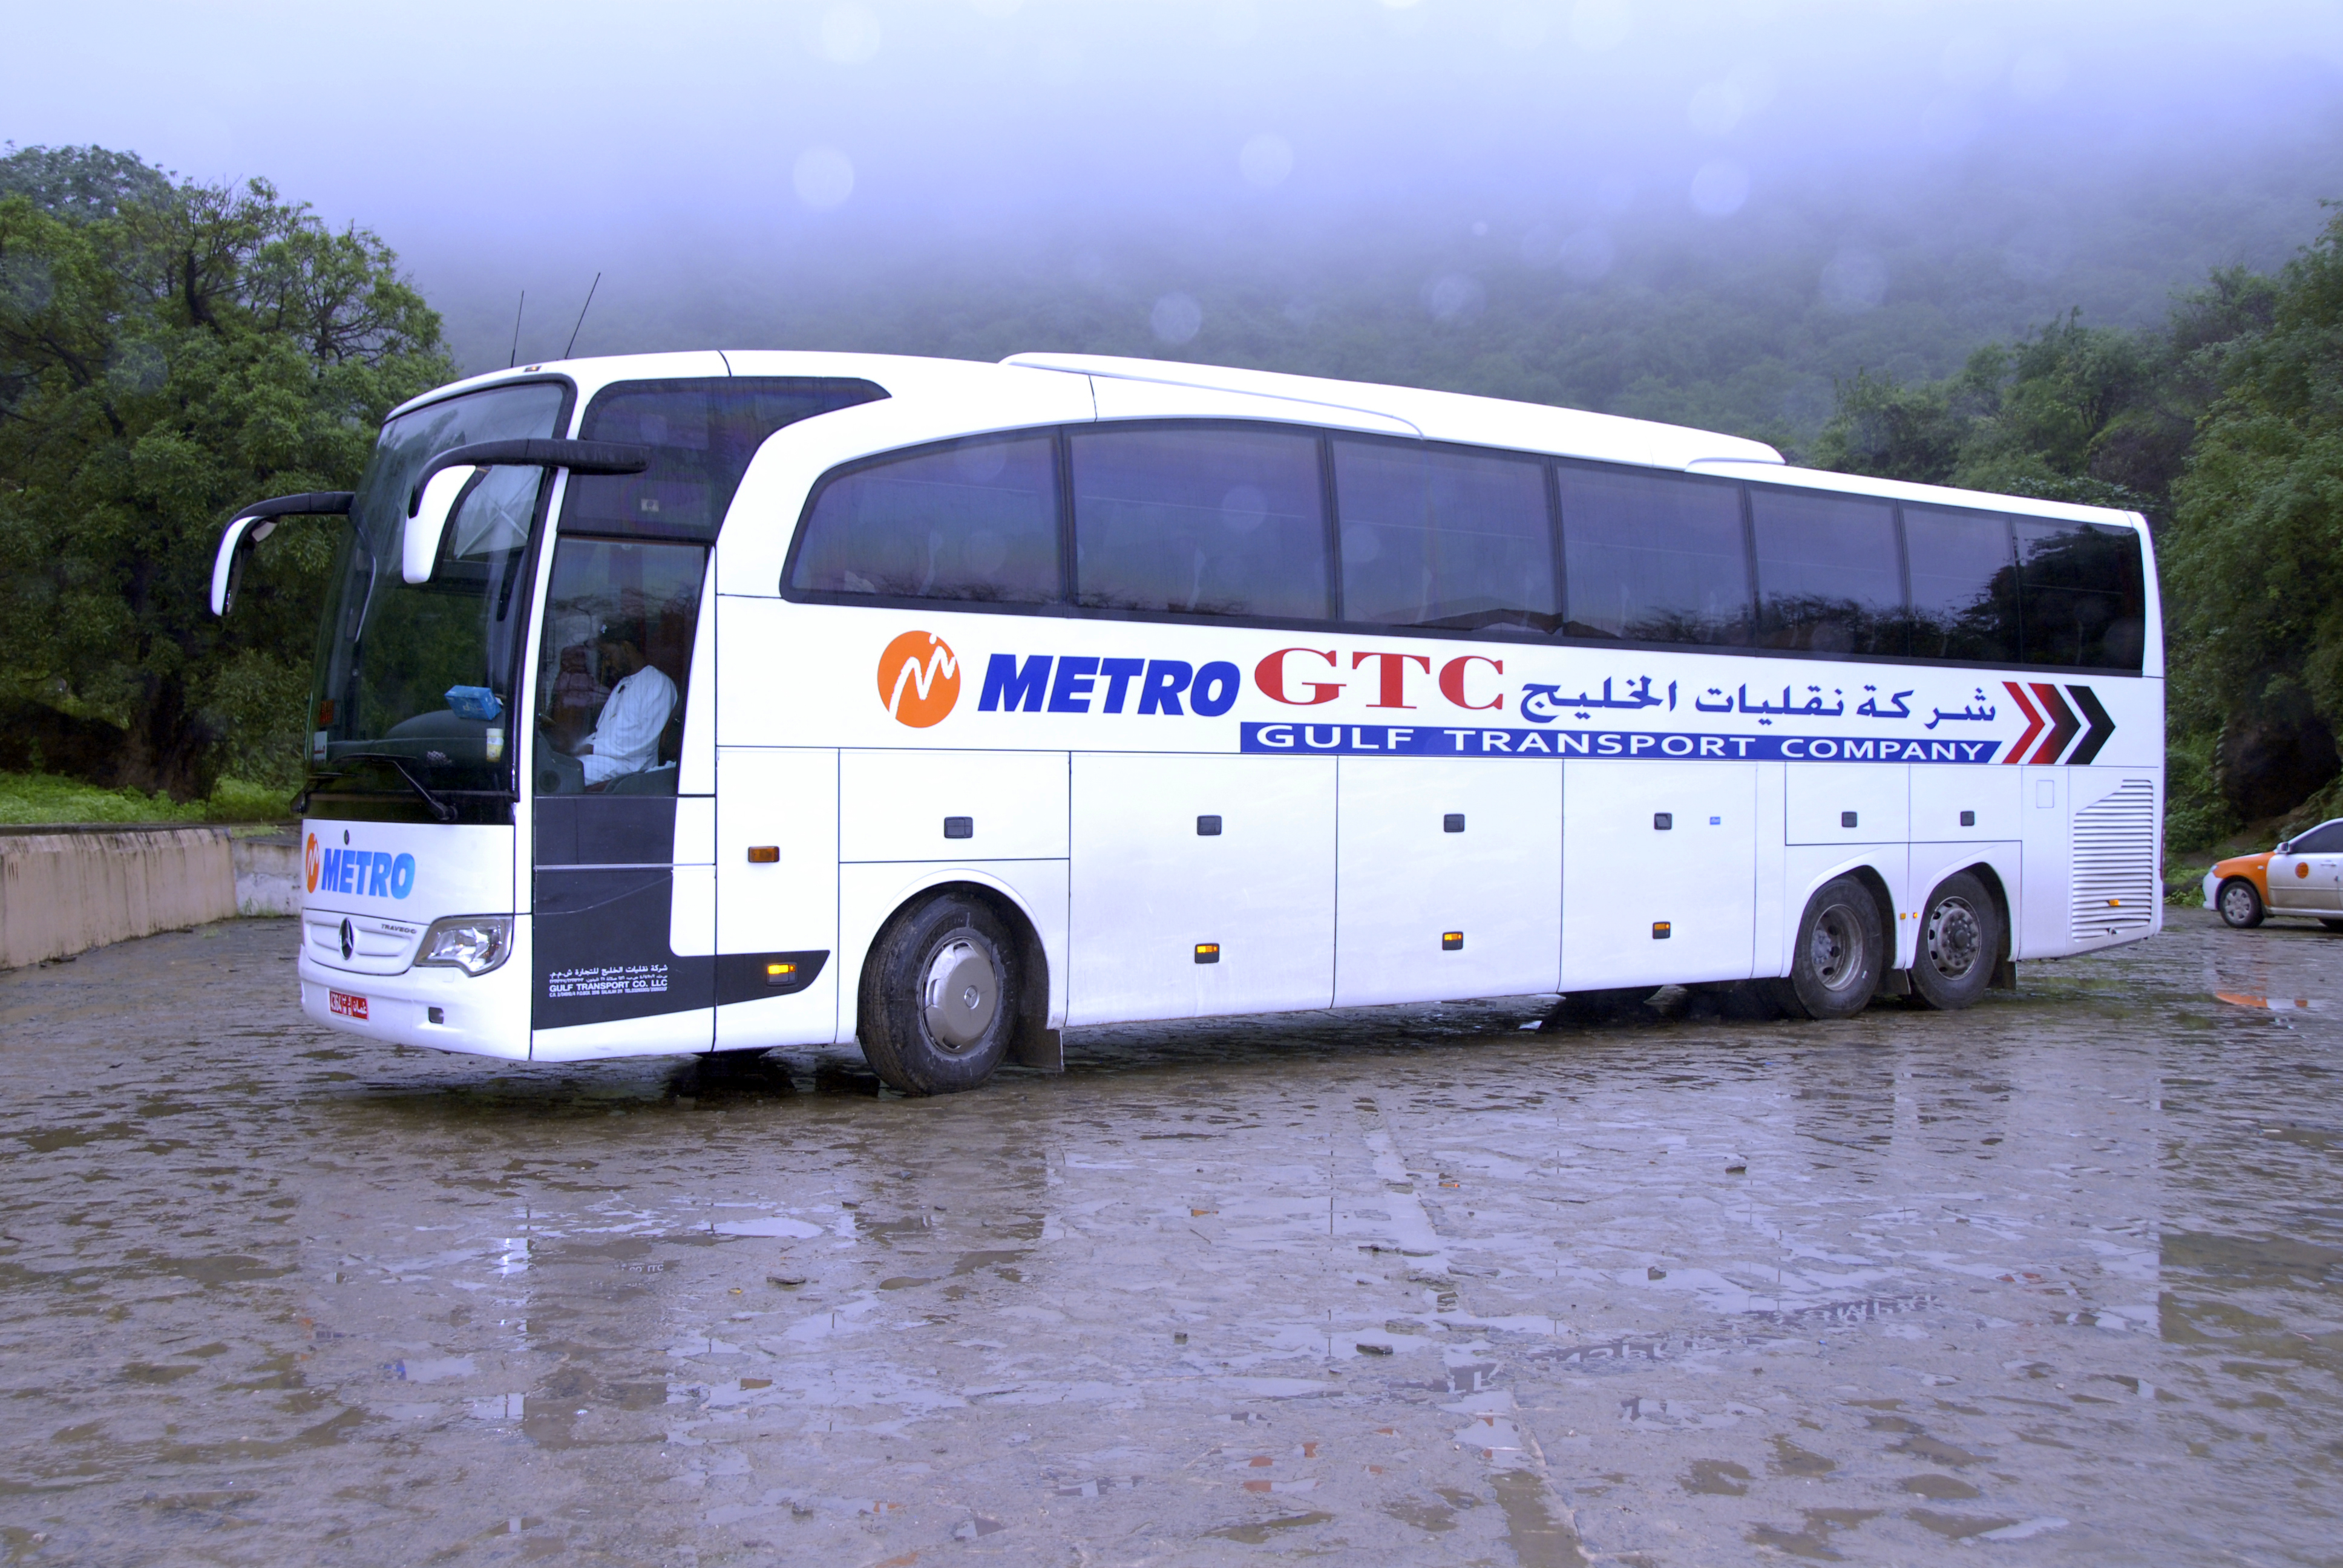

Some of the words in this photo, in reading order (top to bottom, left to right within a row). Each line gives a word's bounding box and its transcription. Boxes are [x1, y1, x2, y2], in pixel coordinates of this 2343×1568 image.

[978, 653, 1240, 717] METRO
[1254, 648, 1504, 710] GTC
[1520, 675, 1677, 724] الخليج
[1695, 682, 1844, 725] نقليات
[1857, 684, 1996, 730] شركة
[1256, 725, 1414, 750] GULF
[1443, 729, 1756, 757] TRANSPORT
[1780, 738, 1985, 761] COMPANY
[321, 848, 416, 900] METRO
[381, 923, 417, 934] TRAVEGO
[549, 984, 574, 993] GULF
[576, 981, 630, 991] TRANSPORT
[632, 980, 648, 988] CO.
[650, 979, 668, 987] LLC
